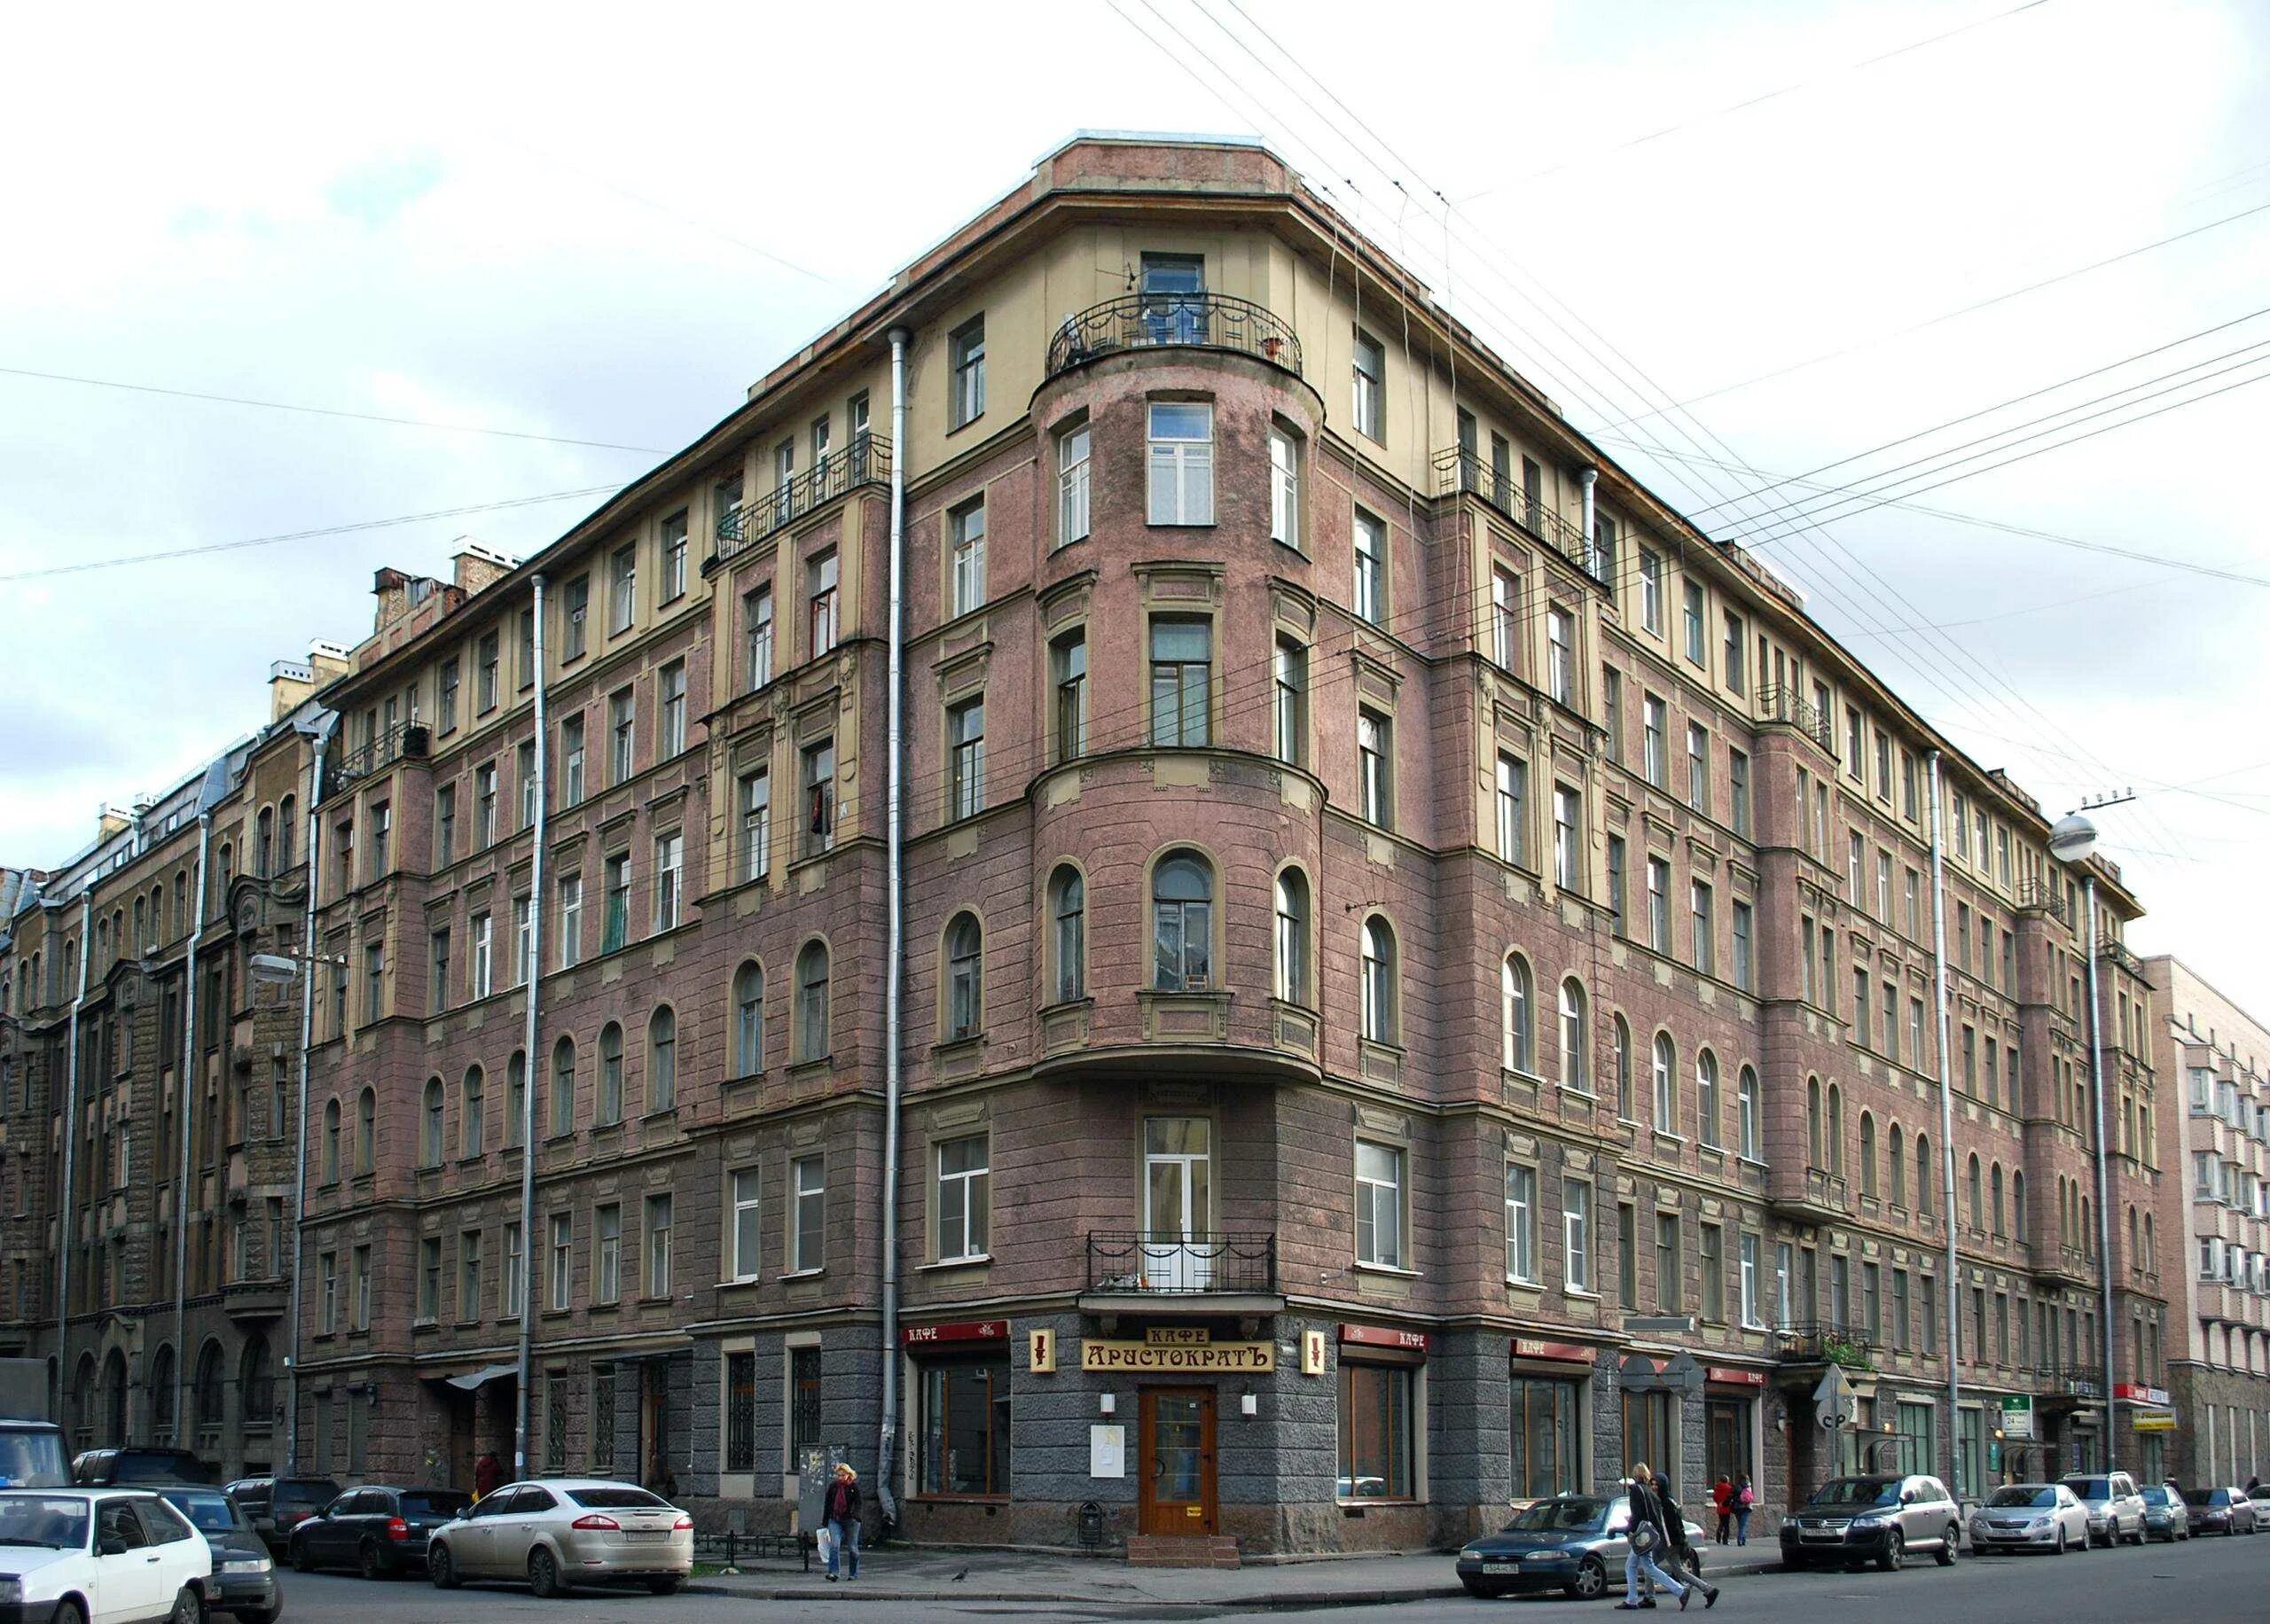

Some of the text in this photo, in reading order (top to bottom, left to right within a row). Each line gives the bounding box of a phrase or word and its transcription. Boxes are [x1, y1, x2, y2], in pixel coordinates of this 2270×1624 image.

[908, 1327, 938, 1341] КАФЕ
[1151, 1330, 1205, 1342] КАФЕ
[1399, 1332, 1425, 1347] КАФЕ
[1522, 1340, 1545, 1355] КАФЕ
